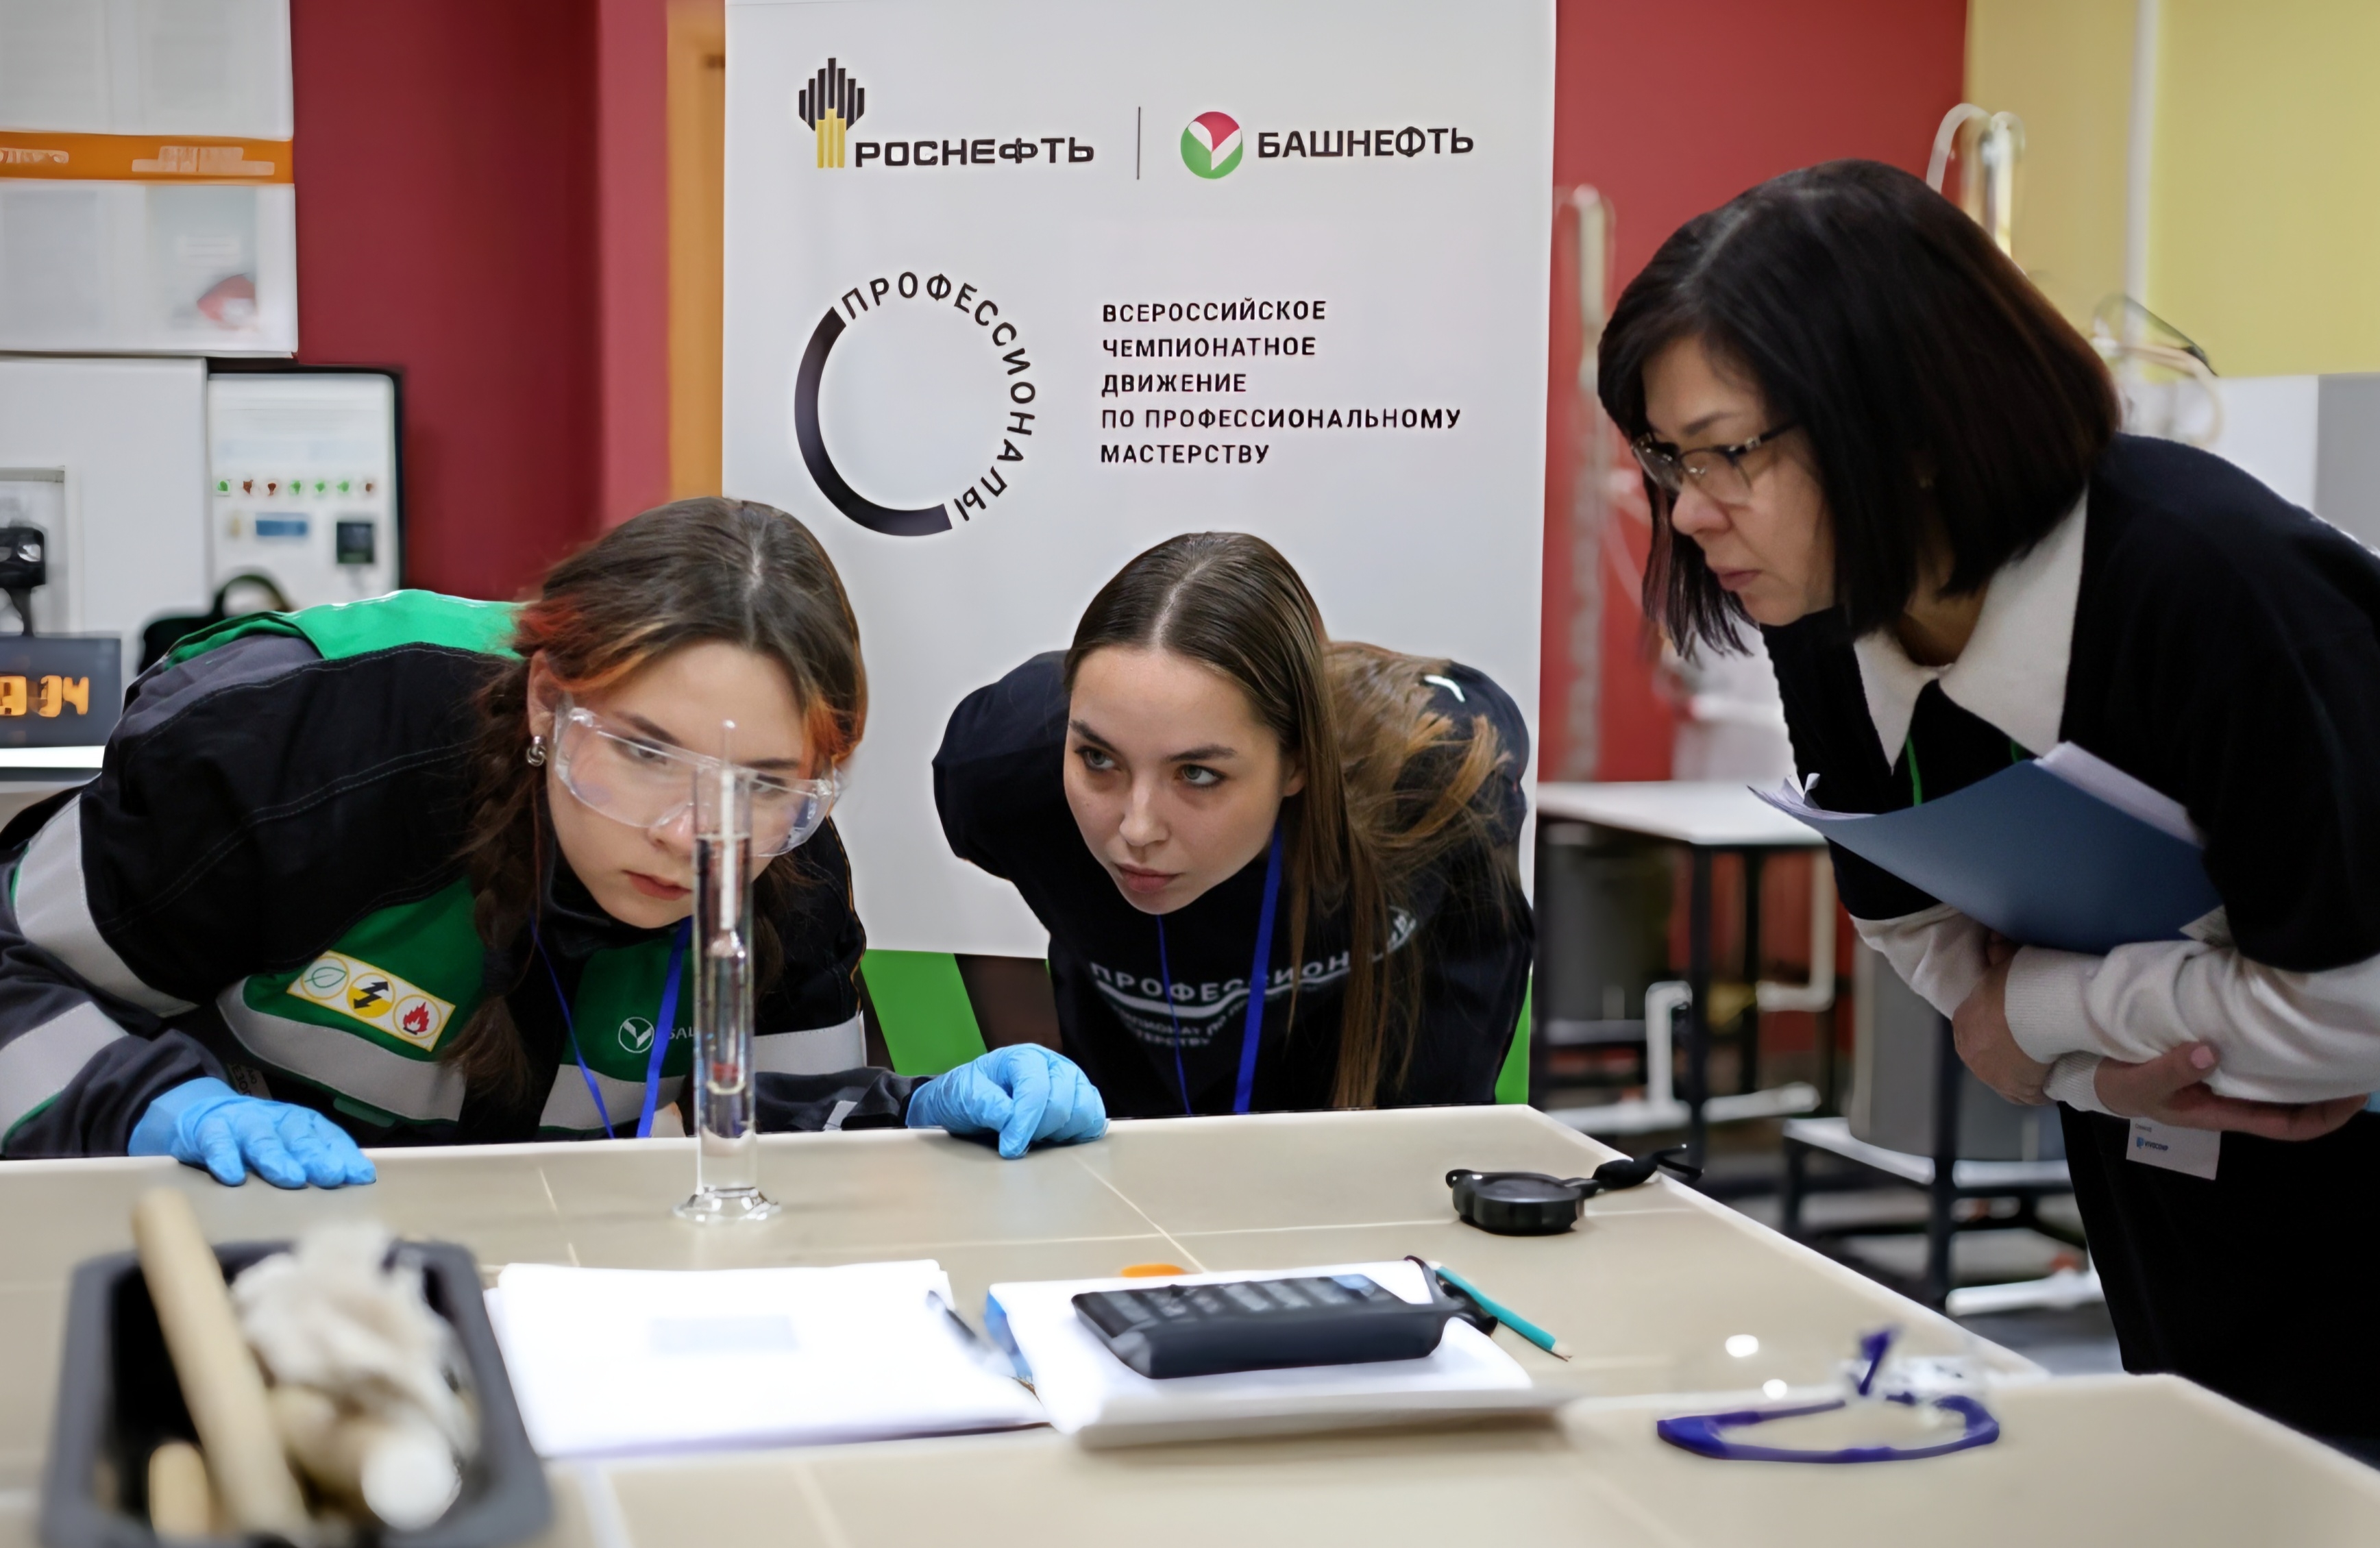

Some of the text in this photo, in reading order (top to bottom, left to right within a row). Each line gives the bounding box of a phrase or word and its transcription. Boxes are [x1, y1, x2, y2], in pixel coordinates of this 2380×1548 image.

[855, 136, 1095, 169] РОСНЕФТЬ
[1258, 126, 1475, 158] БАШНЕФТЬ
[1103, 297, 1327, 323] ВСЕРОССИЙСКОЕ
[1103, 336, 1316, 358] ЧЕМПИОНАТНОЕ
[841, 271, 1036, 521] ПРОФЕССИОНАЛЫ
[1101, 373, 1247, 398] ДВИЖЕНИЕ
[1102, 408, 1461, 430] ПО ПРОФЕССИОНАЛЬНОМУ
[1101, 443, 1270, 465] МАСТЕРСТВУ
